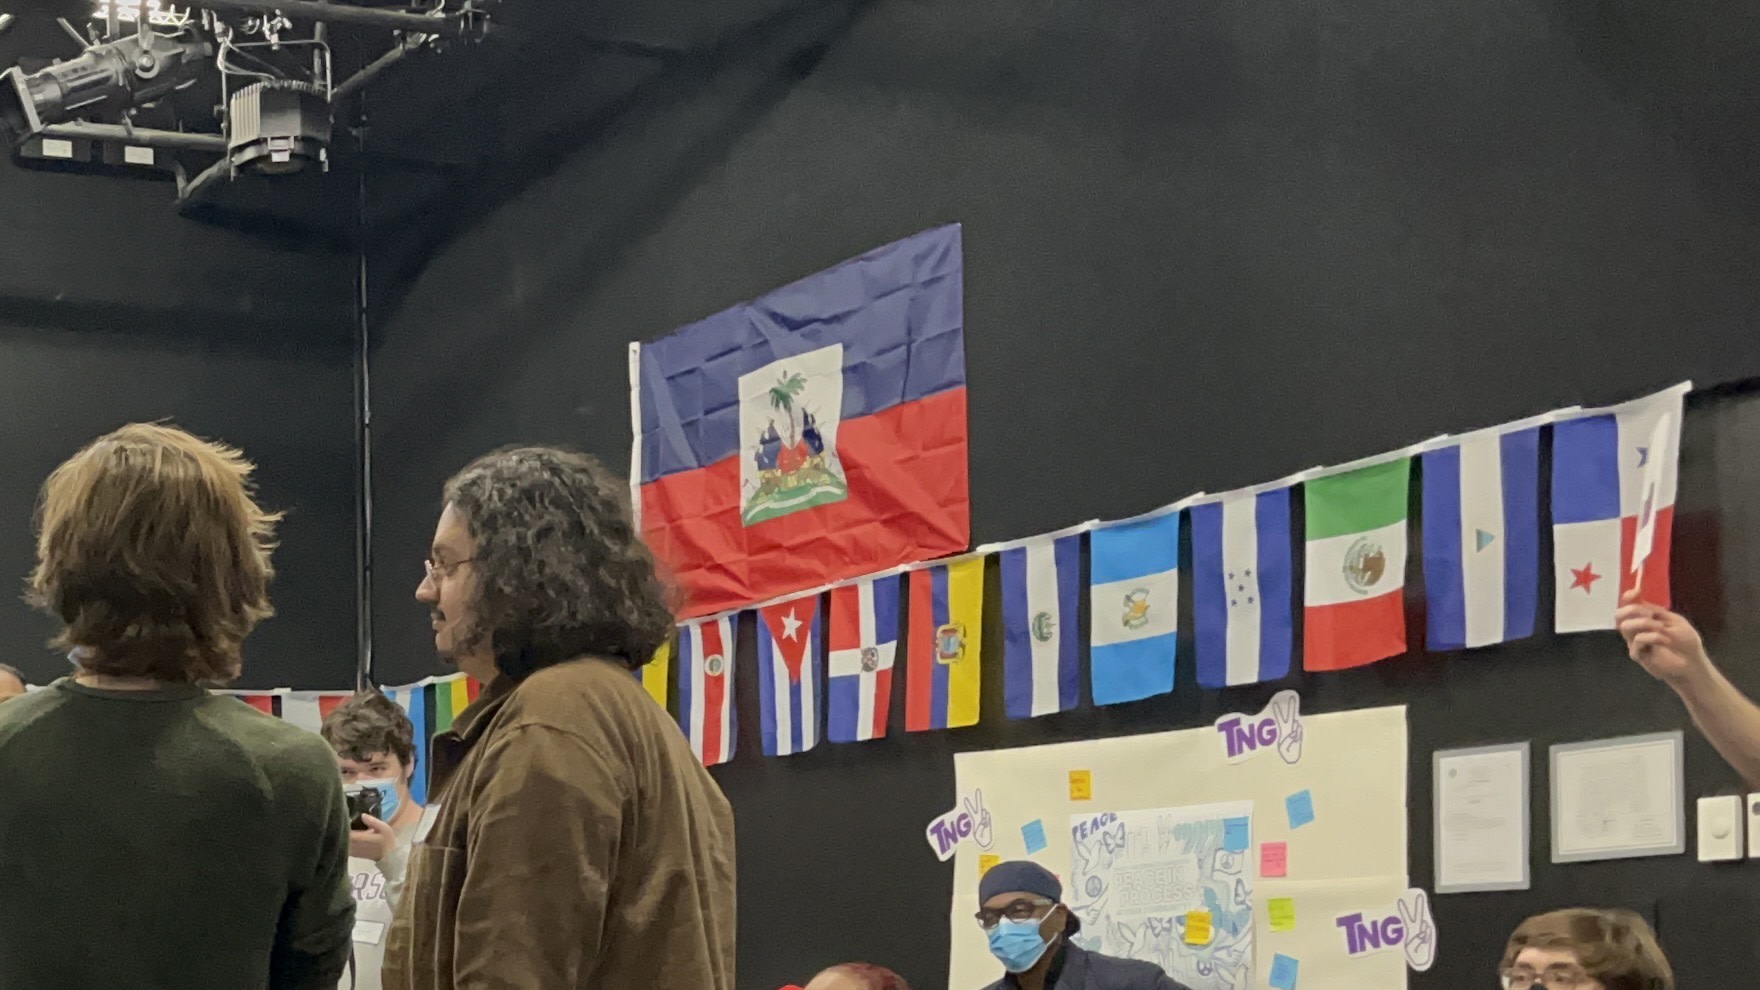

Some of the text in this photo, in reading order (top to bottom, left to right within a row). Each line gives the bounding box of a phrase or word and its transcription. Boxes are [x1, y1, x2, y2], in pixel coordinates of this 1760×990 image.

[1217, 717, 1278, 758] TNG
[929, 812, 972, 855] TNG
[1114, 867, 1166, 888] PEACE
[1119, 882, 1194, 908] PROCESS
[1336, 912, 1404, 955] TNG
